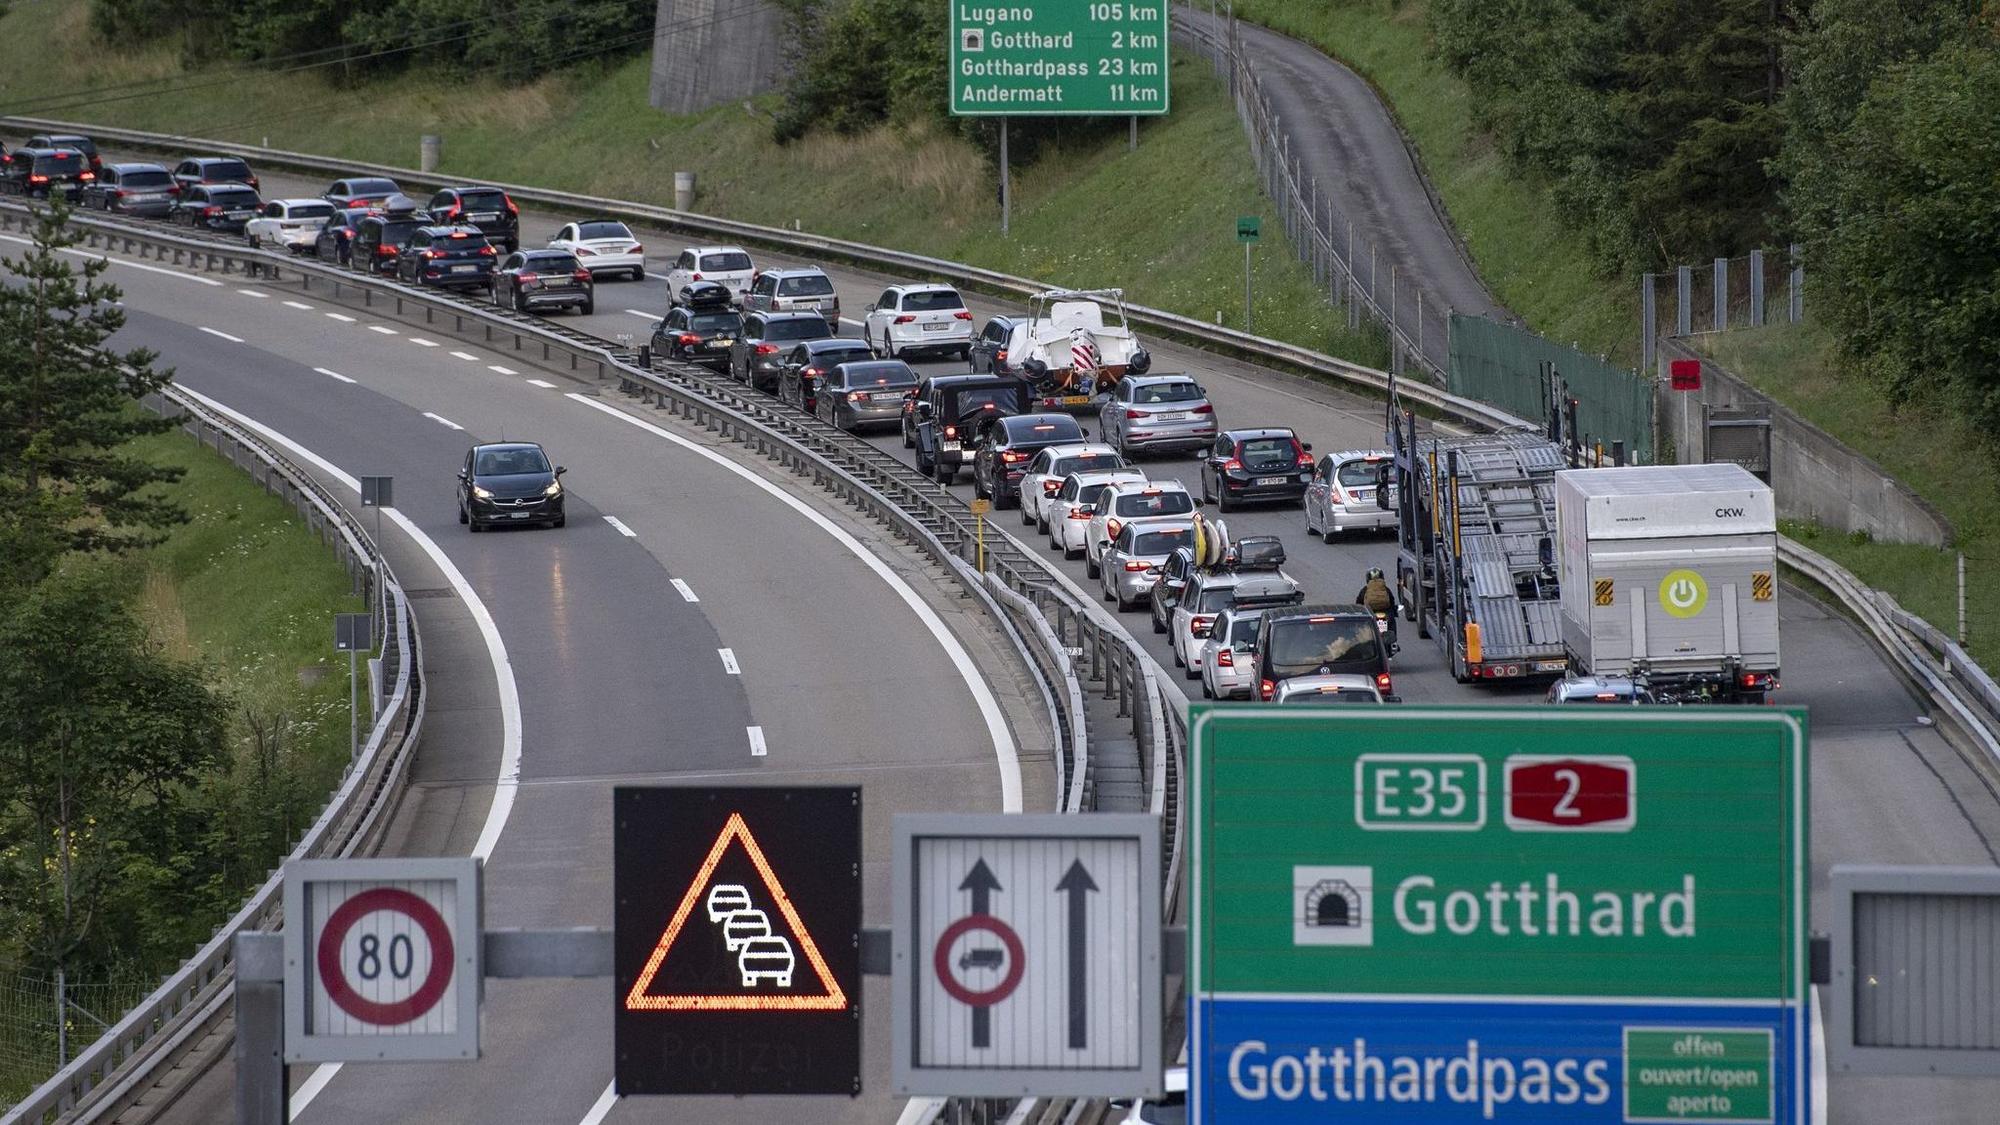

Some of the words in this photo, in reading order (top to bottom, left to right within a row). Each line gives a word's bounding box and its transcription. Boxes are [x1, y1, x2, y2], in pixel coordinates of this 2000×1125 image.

[961, 4, 1033, 25] Lugano
[1089, 3, 1123, 21] 105
[1129, 3, 1158, 21] km
[991, 31, 1073, 49] Gotthard
[1111, 31, 1123, 49] 2
[1129, 31, 1158, 49] km
[961, 58, 1089, 80] Gotthardpass
[1098, 58, 1124, 76] 23
[1130, 58, 1158, 76] km
[962, 84, 1063, 102] Andermatt
[1110, 84, 1124, 101] 11
[1130, 84, 1158, 101] km
[1376, 769, 1466, 816] E35
[1553, 769, 1582, 818] 2
[1393, 873, 1696, 937] Gotthard
[358, 933, 414, 980] 80
[1673, 1036, 1725, 1056] offen
[1228, 1038, 1611, 1119] Gotthardpass
[1640, 1067, 1759, 1089] ouvert/open
[1668, 1095, 1730, 1116] aperto
